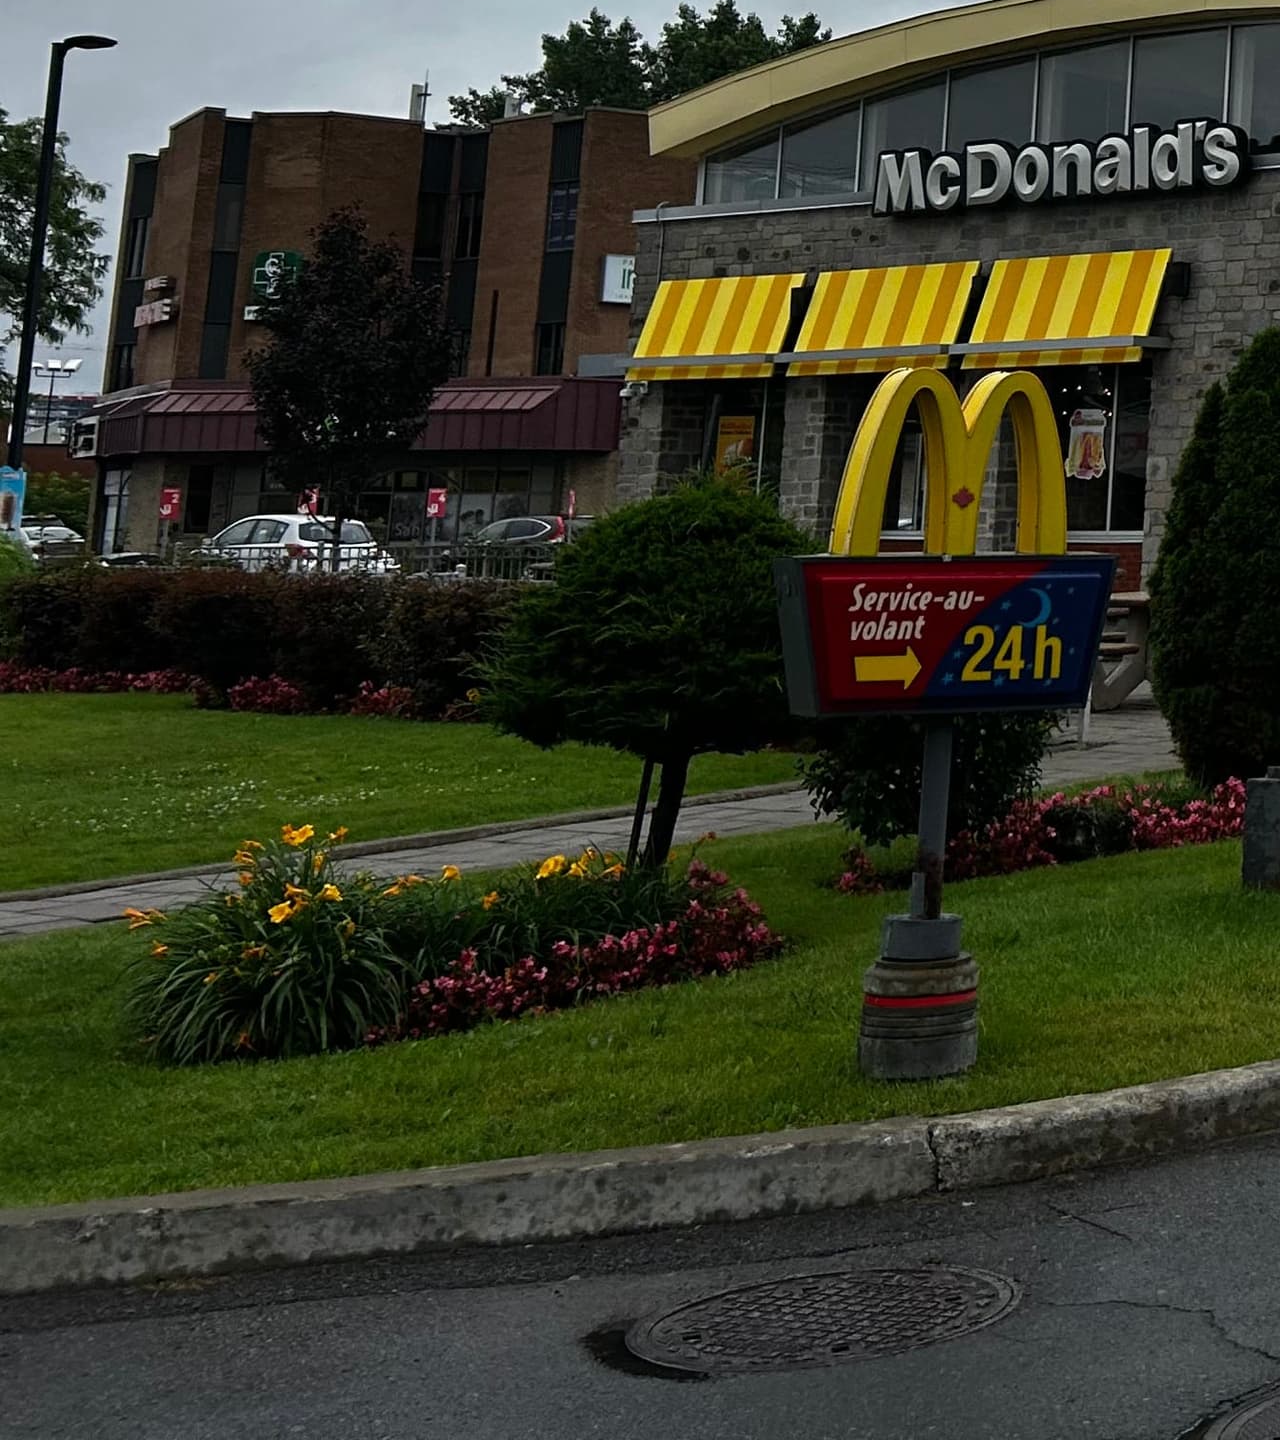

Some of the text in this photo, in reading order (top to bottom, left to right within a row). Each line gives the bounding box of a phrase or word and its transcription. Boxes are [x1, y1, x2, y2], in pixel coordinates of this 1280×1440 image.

[873, 118, 1242, 215] McDonald's
[847, 582, 986, 613] Service-au-
[850, 611, 926, 641] volant
[960, 624, 1064, 683] 24h
